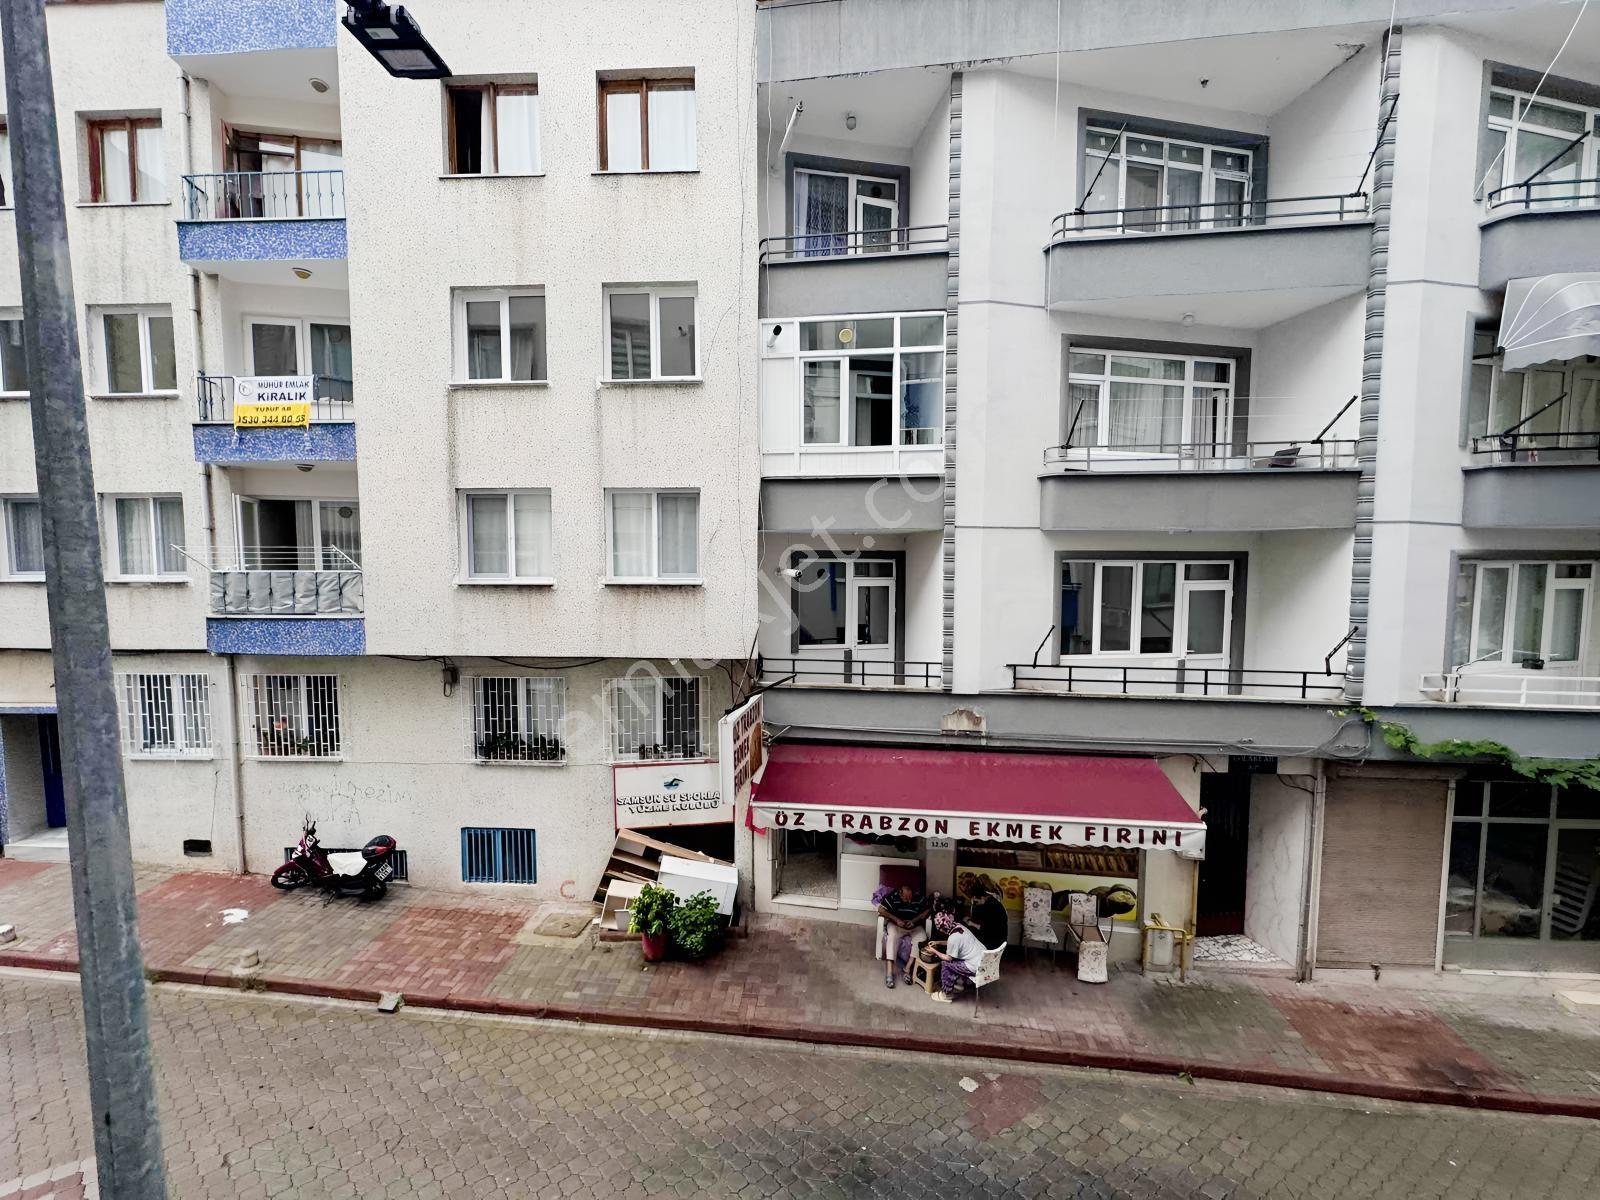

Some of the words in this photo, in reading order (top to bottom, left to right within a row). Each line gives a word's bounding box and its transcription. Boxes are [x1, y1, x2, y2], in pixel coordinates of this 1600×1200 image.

[285, 380, 310, 389] EMLAK
[616, 794, 661, 806] SAMSUN
[663, 793, 676, 803] SU
[774, 810, 805, 827] ÖZ
[824, 812, 949, 835] TRABZON
[968, 820, 1063, 840] EKMEK
[1084, 825, 1182, 847] FIRINI
